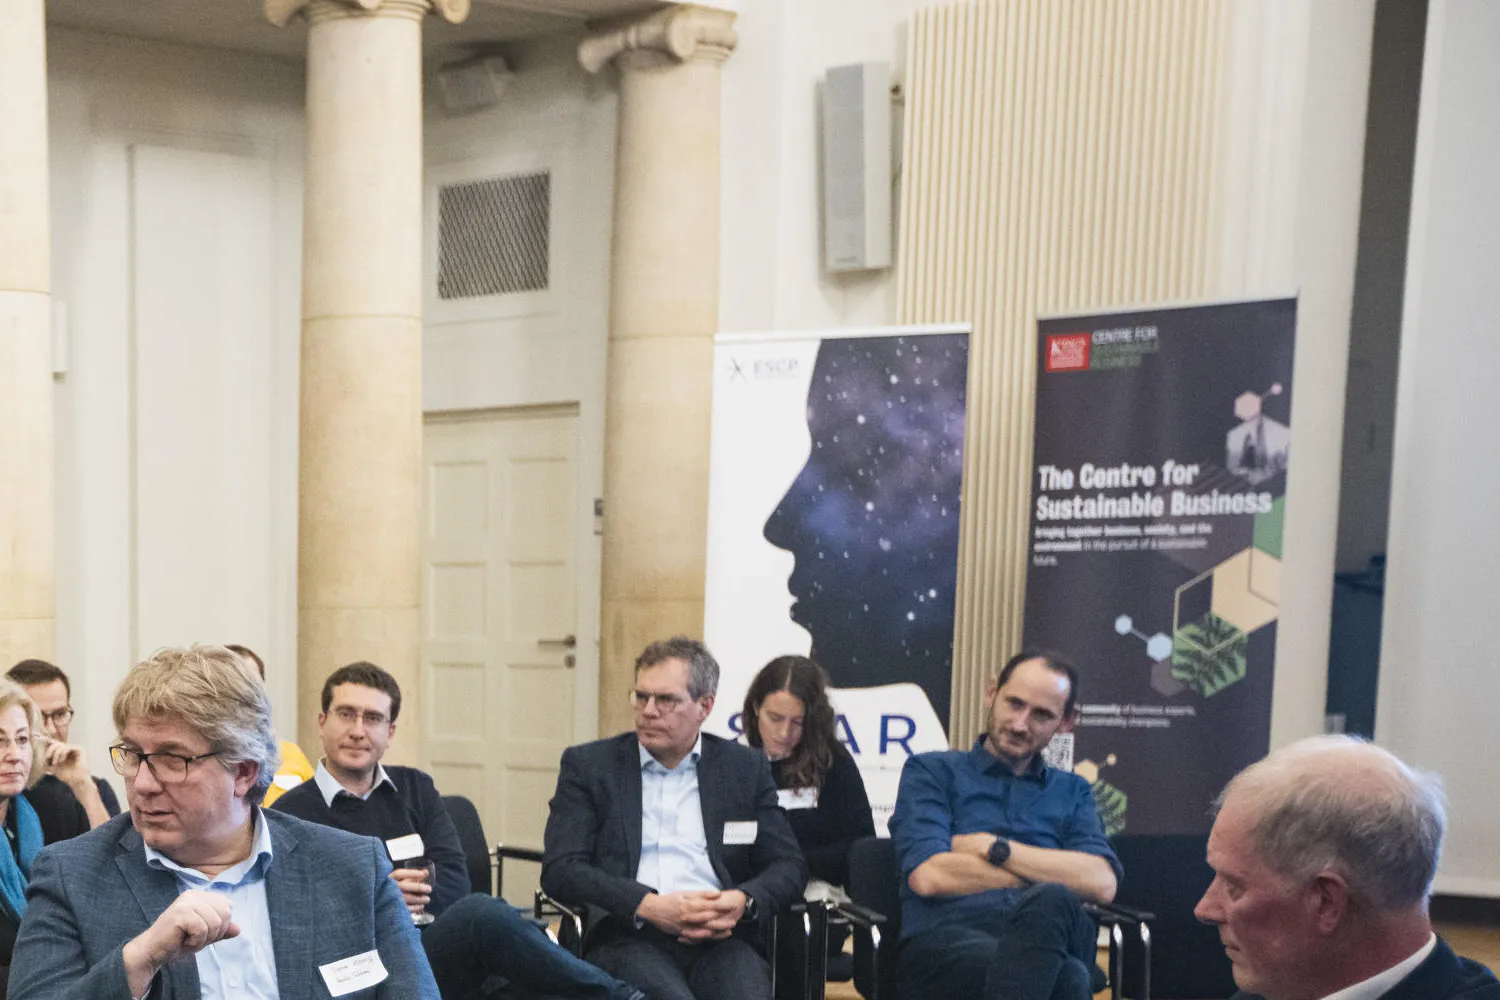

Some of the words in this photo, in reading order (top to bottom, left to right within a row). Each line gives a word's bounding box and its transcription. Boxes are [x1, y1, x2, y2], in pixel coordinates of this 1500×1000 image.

[1037, 465, 1075, 491] The
[1079, 462, 1156, 489] Centre
[1162, 459, 1200, 486] for
[1035, 492, 1165, 521] Sustainable
[1170, 488, 1272, 516] Business
